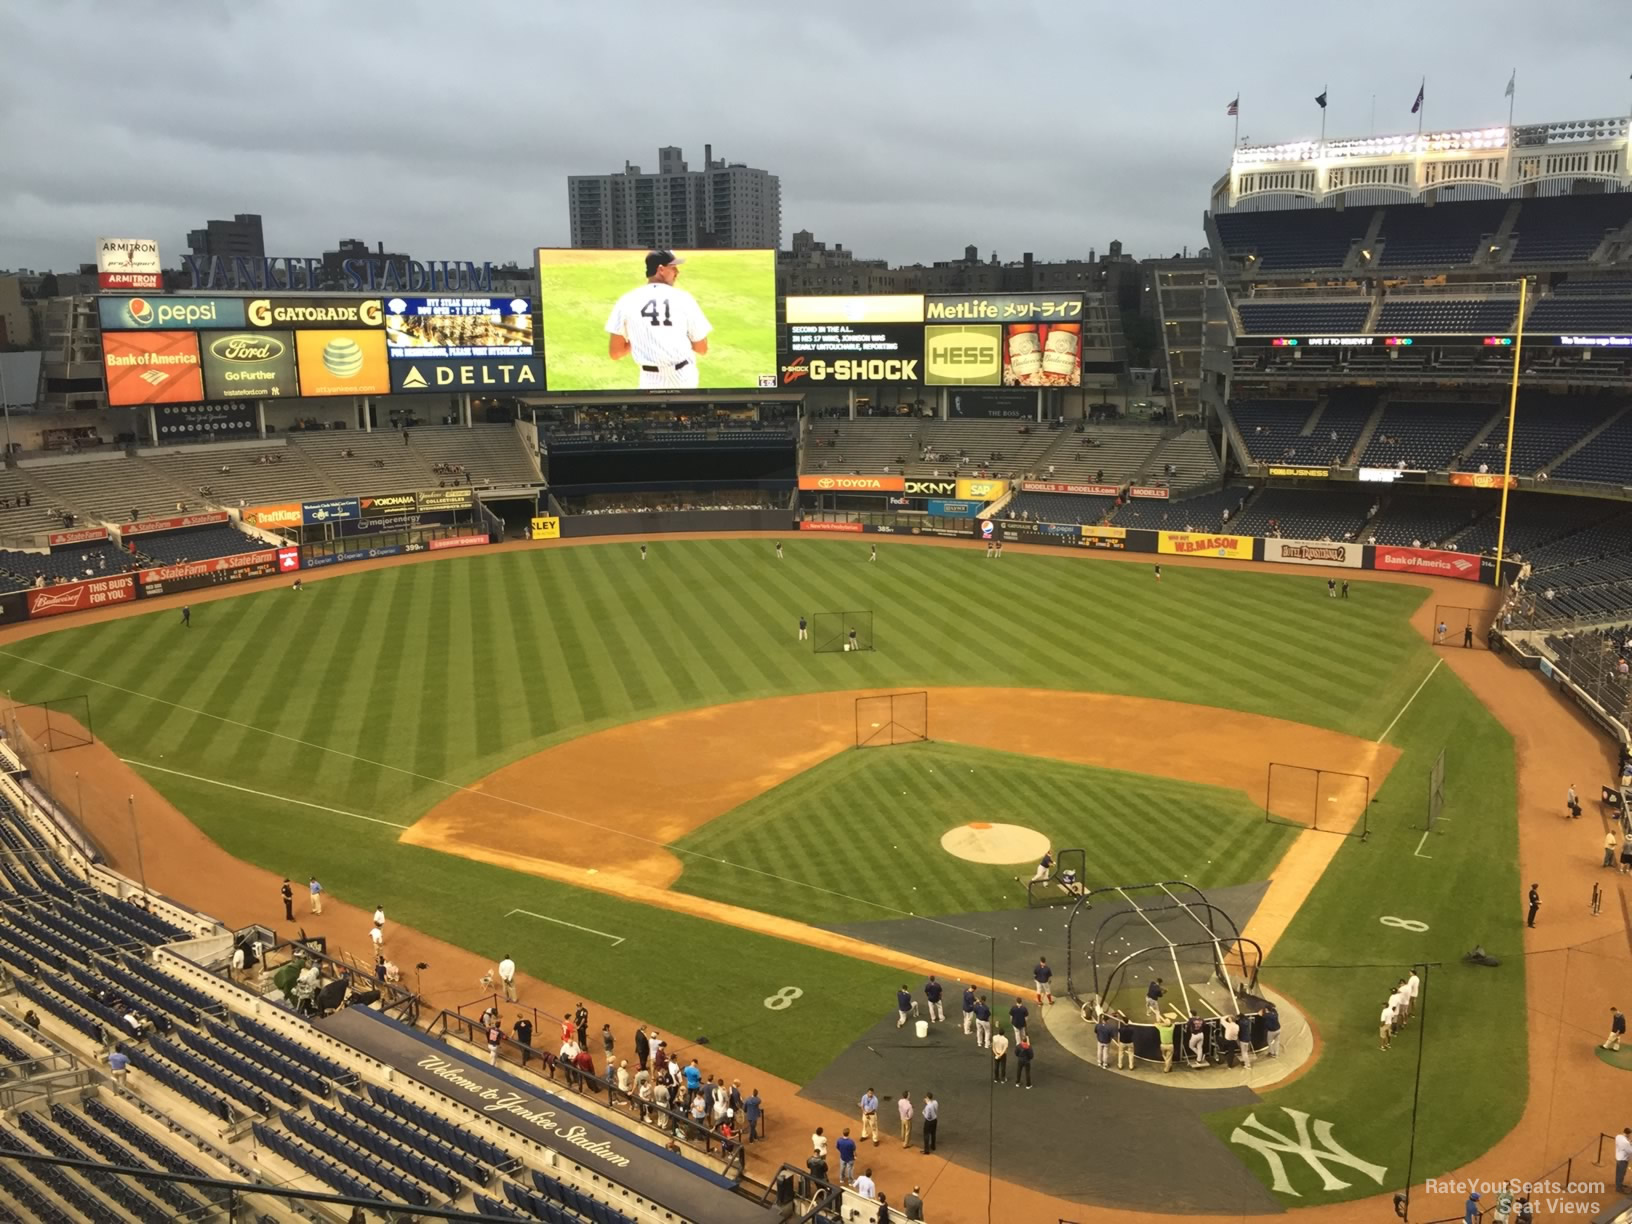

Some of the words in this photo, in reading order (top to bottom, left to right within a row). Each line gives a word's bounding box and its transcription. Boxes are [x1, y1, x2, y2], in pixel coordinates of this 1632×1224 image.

[103, 243, 156, 252] ARMITRON
[109, 275, 156, 283] ARMITRON
[179, 254, 323, 290] YANKEE
[342, 258, 493, 291] STADIUM
[158, 302, 217, 324] pepsi
[274, 307, 358, 321] GATORADE
[641, 299, 672, 326] 41
[927, 300, 998, 318] MetLife
[1003, 301, 1082, 317] メットライフ
[225, 339, 270, 358] Ford
[932, 347, 994, 364] HESS
[107, 354, 136, 366] Bank
[137, 354, 150, 364] of
[150, 352, 196, 364] America
[225, 372, 240, 380] Go
[240, 371, 276, 380] Further
[436, 364, 536, 385] DELTA
[810, 360, 918, 380] G-SHOCK
[837, 480, 880, 488] TOYOTA
[905, 482, 956, 494] DKNY
[971, 484, 990, 496] SAP
[373, 496, 415, 506] YOKOHAMA
[890, 496, 910, 504] FedEx
[258, 510, 301, 523] DraftKings
[1282, 545, 1301, 558] HOTEL
[1338, 547, 1346, 562] 2
[314, 557, 332, 565] Experian
[1384, 555, 1406, 564] Bank
[1416, 558, 1451, 569] America
[88, 583, 108, 592] THIS
[108, 578, 133, 590] BUD'S
[37, 594, 80, 608] Budweiser
[90, 594, 106, 604] FOR
[108, 590, 126, 600] YOU.
[764, 986, 803, 1010] 8
[417, 1055, 483, 1093] Welcome
[479, 1087, 498, 1100] to
[484, 1092, 557, 1130] Yankee
[554, 1125, 631, 1168] Stadium
